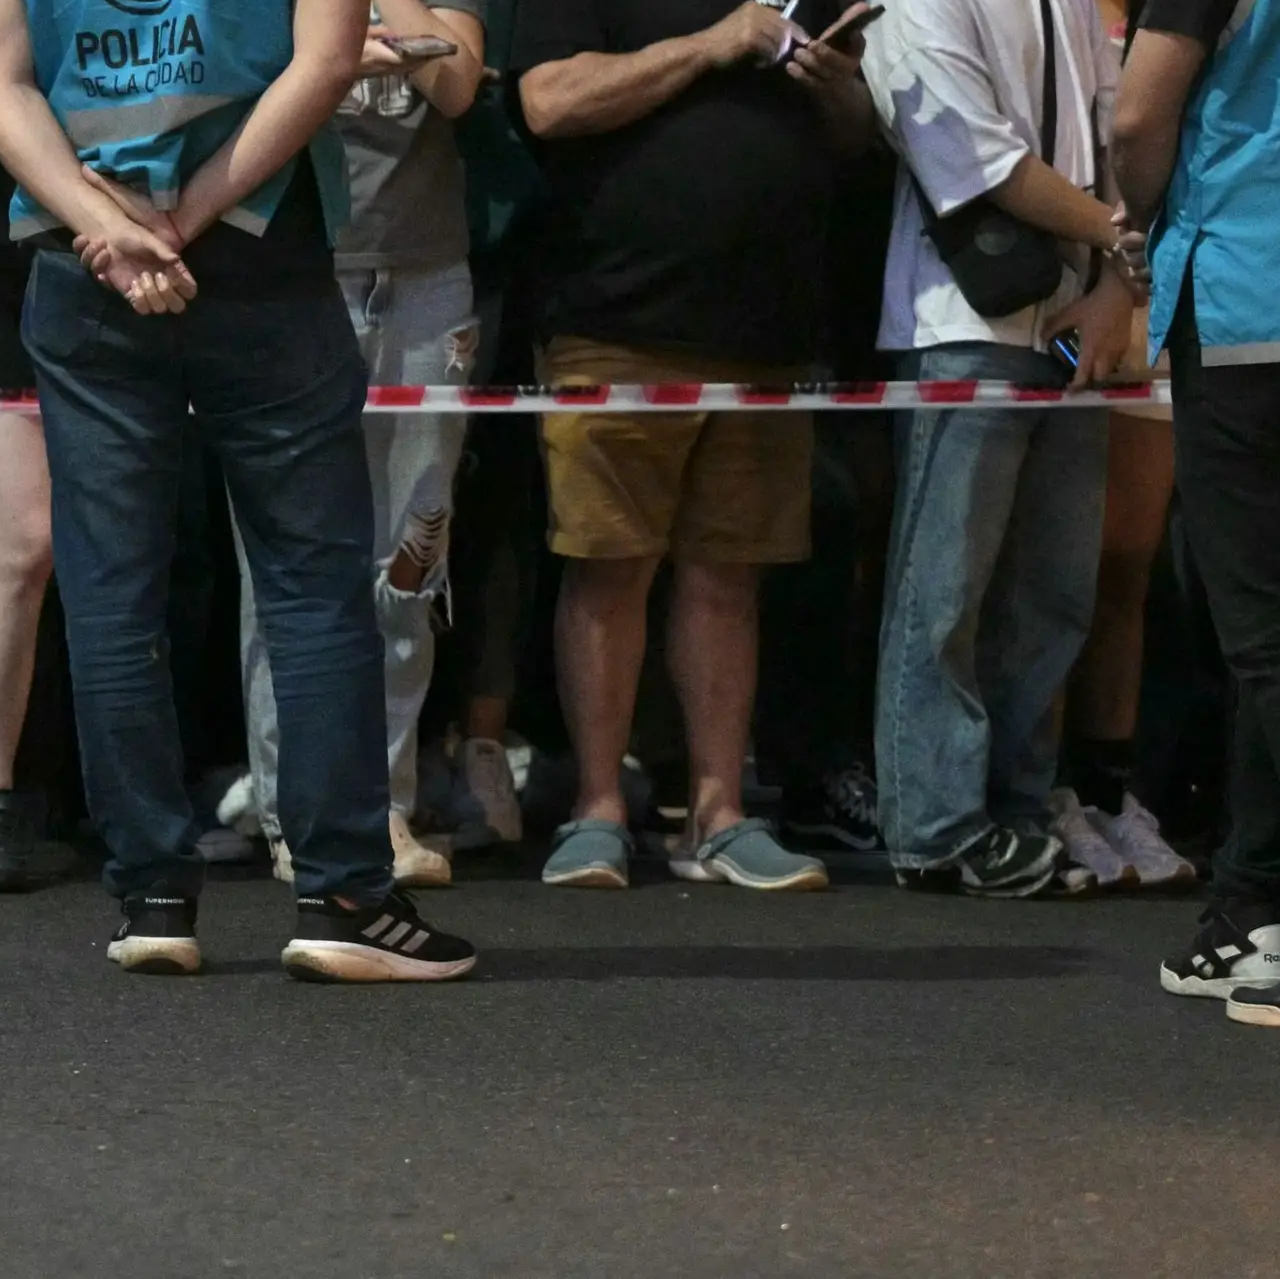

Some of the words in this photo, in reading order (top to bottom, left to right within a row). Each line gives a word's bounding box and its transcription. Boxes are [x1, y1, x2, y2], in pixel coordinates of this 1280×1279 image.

[75, 14, 205, 71] POLICIA
[80, 76, 108, 98] DE
[114, 73, 140, 95] LA
